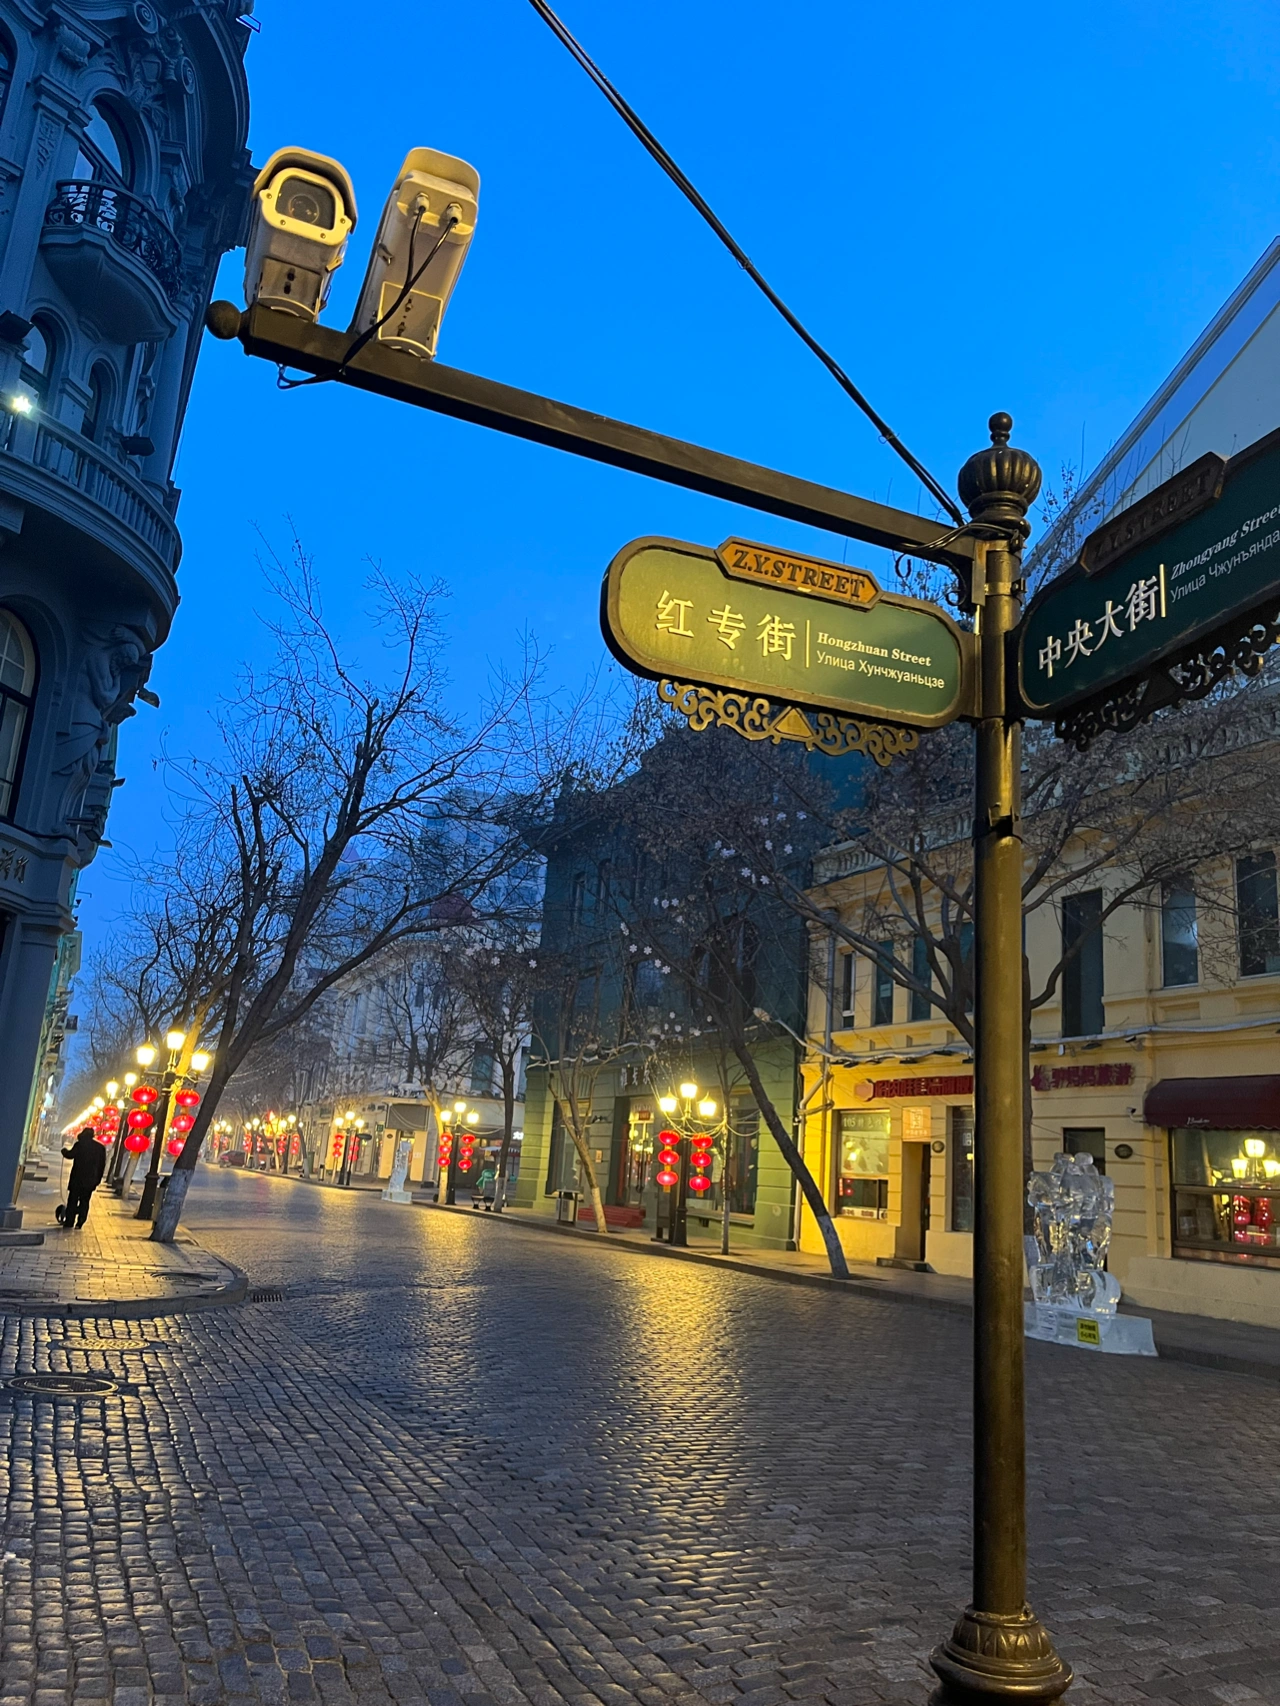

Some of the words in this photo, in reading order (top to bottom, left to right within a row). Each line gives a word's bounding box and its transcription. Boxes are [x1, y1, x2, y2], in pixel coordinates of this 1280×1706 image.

[731, 548, 866, 598] Z.Y.STREET
[1170, 530, 1239, 581] Zhongyang
[1170, 574, 1206, 603] Улица
[655, 589, 797, 661] 红专街
[816, 631, 888, 658] Hongzhuan
[891, 648, 932, 667] Street
[1038, 575, 1159, 678] 中央大街
[816, 650, 856, 672] Улица
[858, 659, 945, 689] Хунчжуаньцзе
